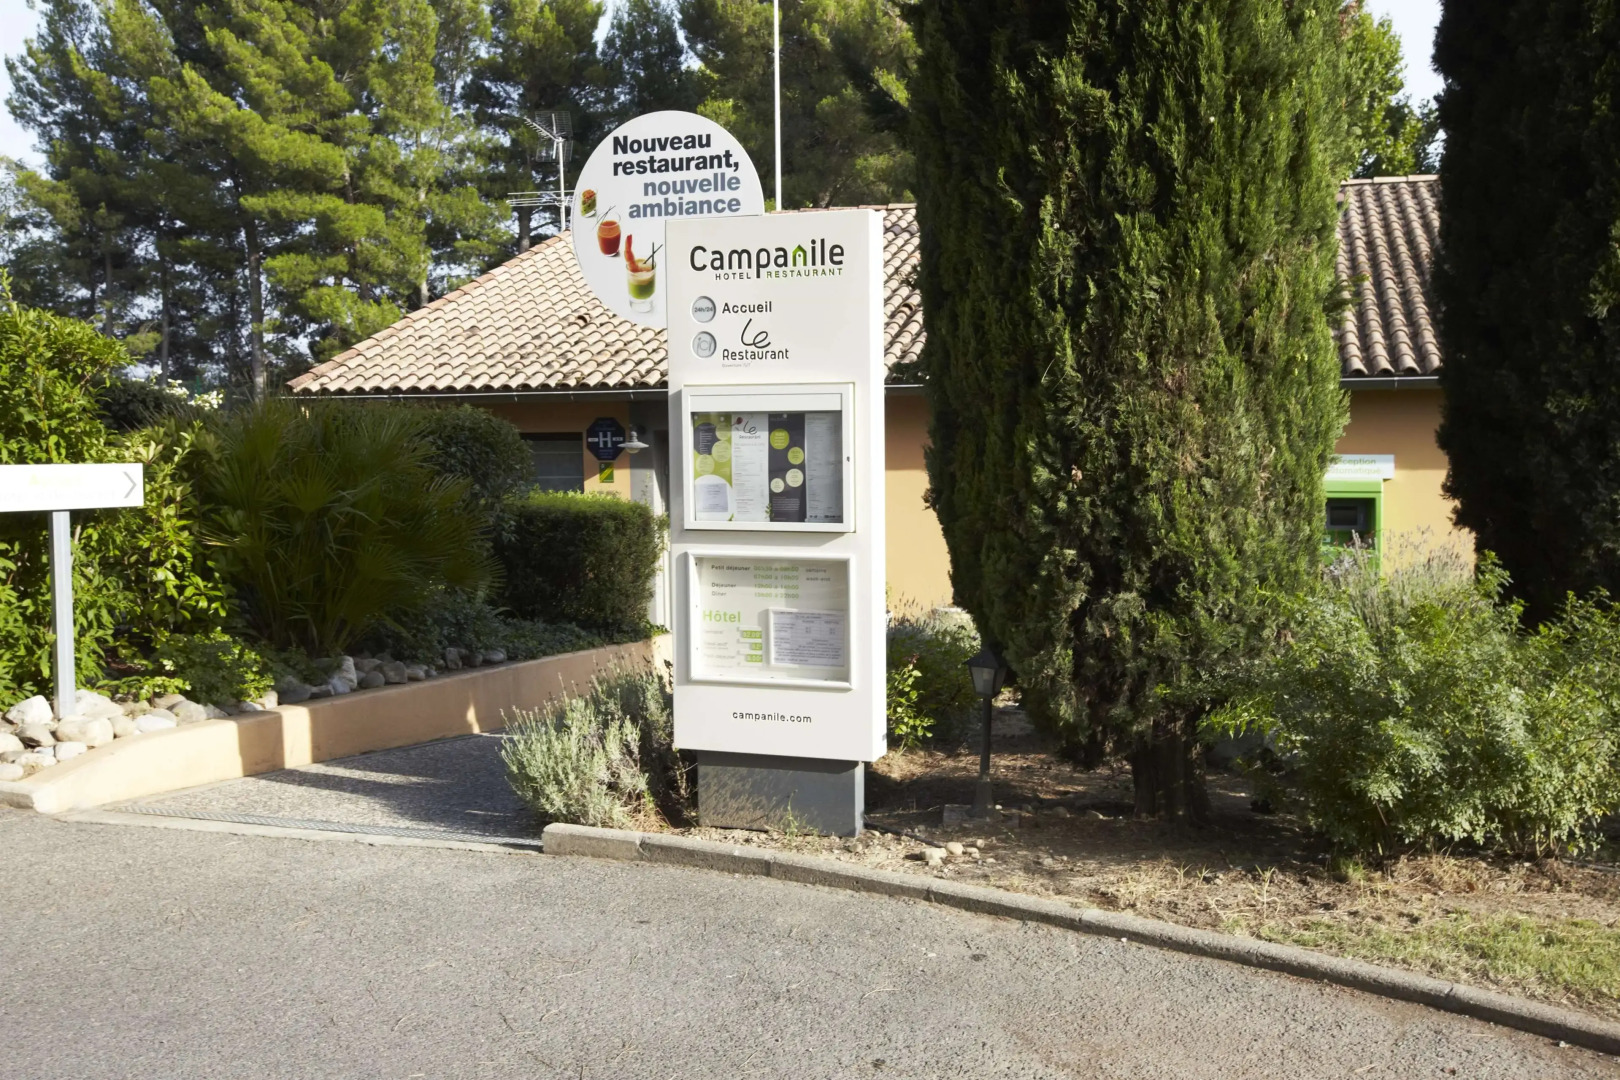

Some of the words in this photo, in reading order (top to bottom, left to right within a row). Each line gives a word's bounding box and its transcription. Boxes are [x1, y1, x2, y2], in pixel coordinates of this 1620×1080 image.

[613, 133, 711, 155] Nouveau
[613, 149, 739, 176] restaurant,
[643, 172, 741, 196] nouvelle
[628, 197, 741, 219] ambiance
[690, 238, 845, 279] Campanile
[715, 272, 752, 280] HOTEL
[766, 268, 843, 279] RESTAURANT
[722, 301, 772, 314] Accueil
[722, 348, 789, 361] Restaurant
[599, 432, 612, 448] H
[703, 609, 741, 623] Hôtel
[732, 711, 812, 723] campanile.com
